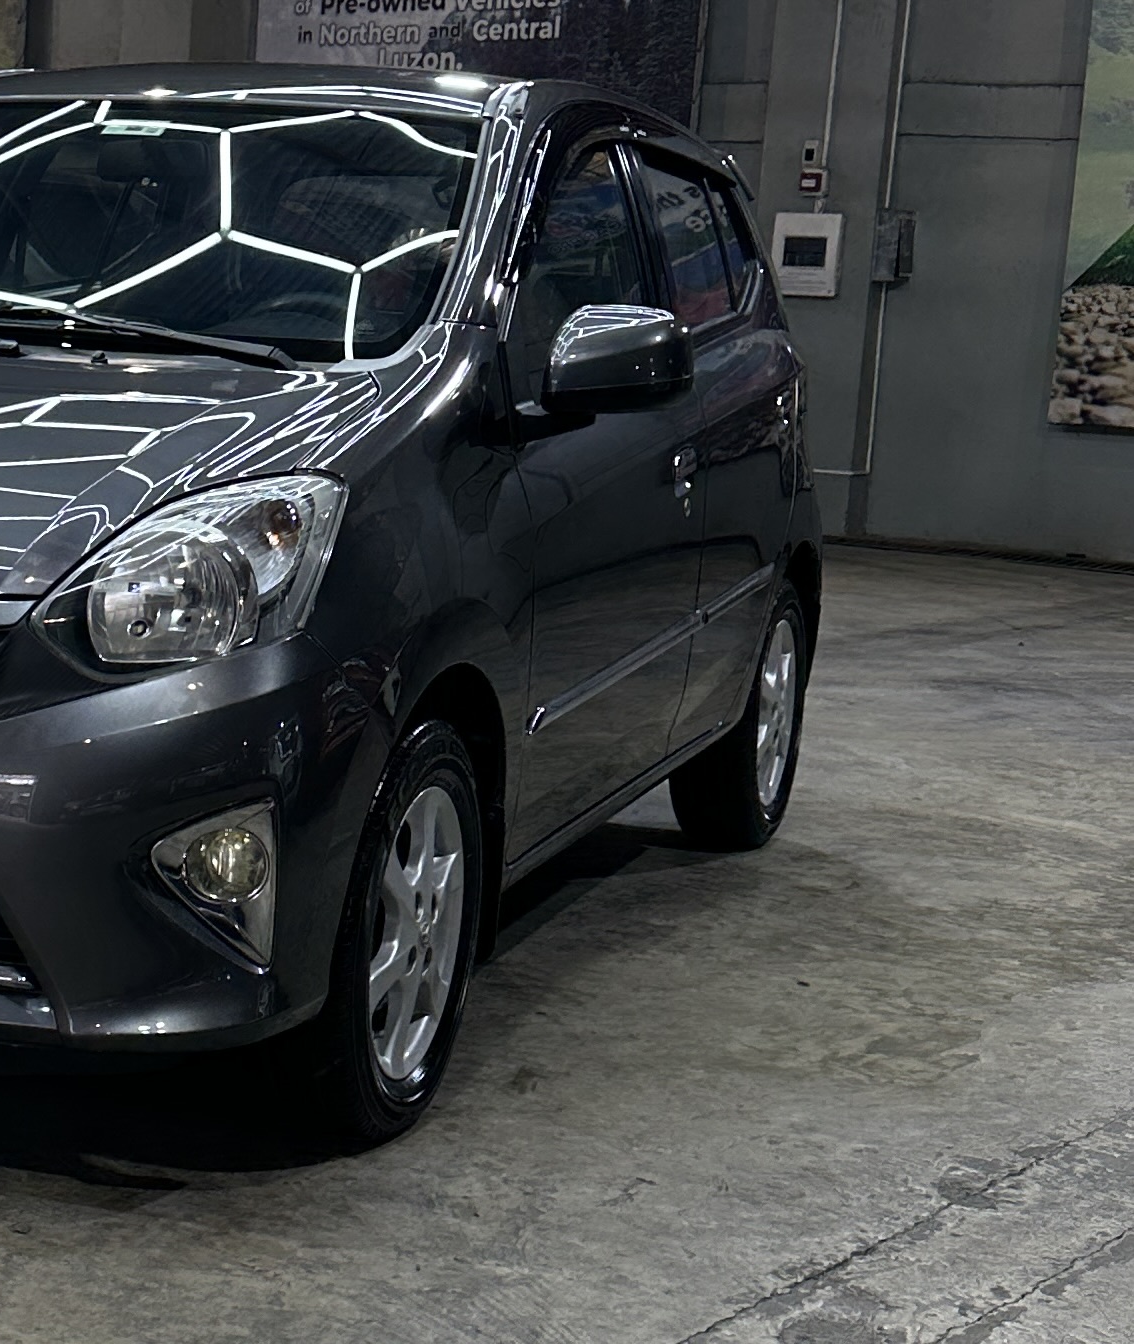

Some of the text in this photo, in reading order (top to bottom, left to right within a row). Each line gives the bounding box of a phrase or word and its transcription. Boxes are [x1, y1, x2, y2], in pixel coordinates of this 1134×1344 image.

[298, 15, 562, 47] in Northern and Central
